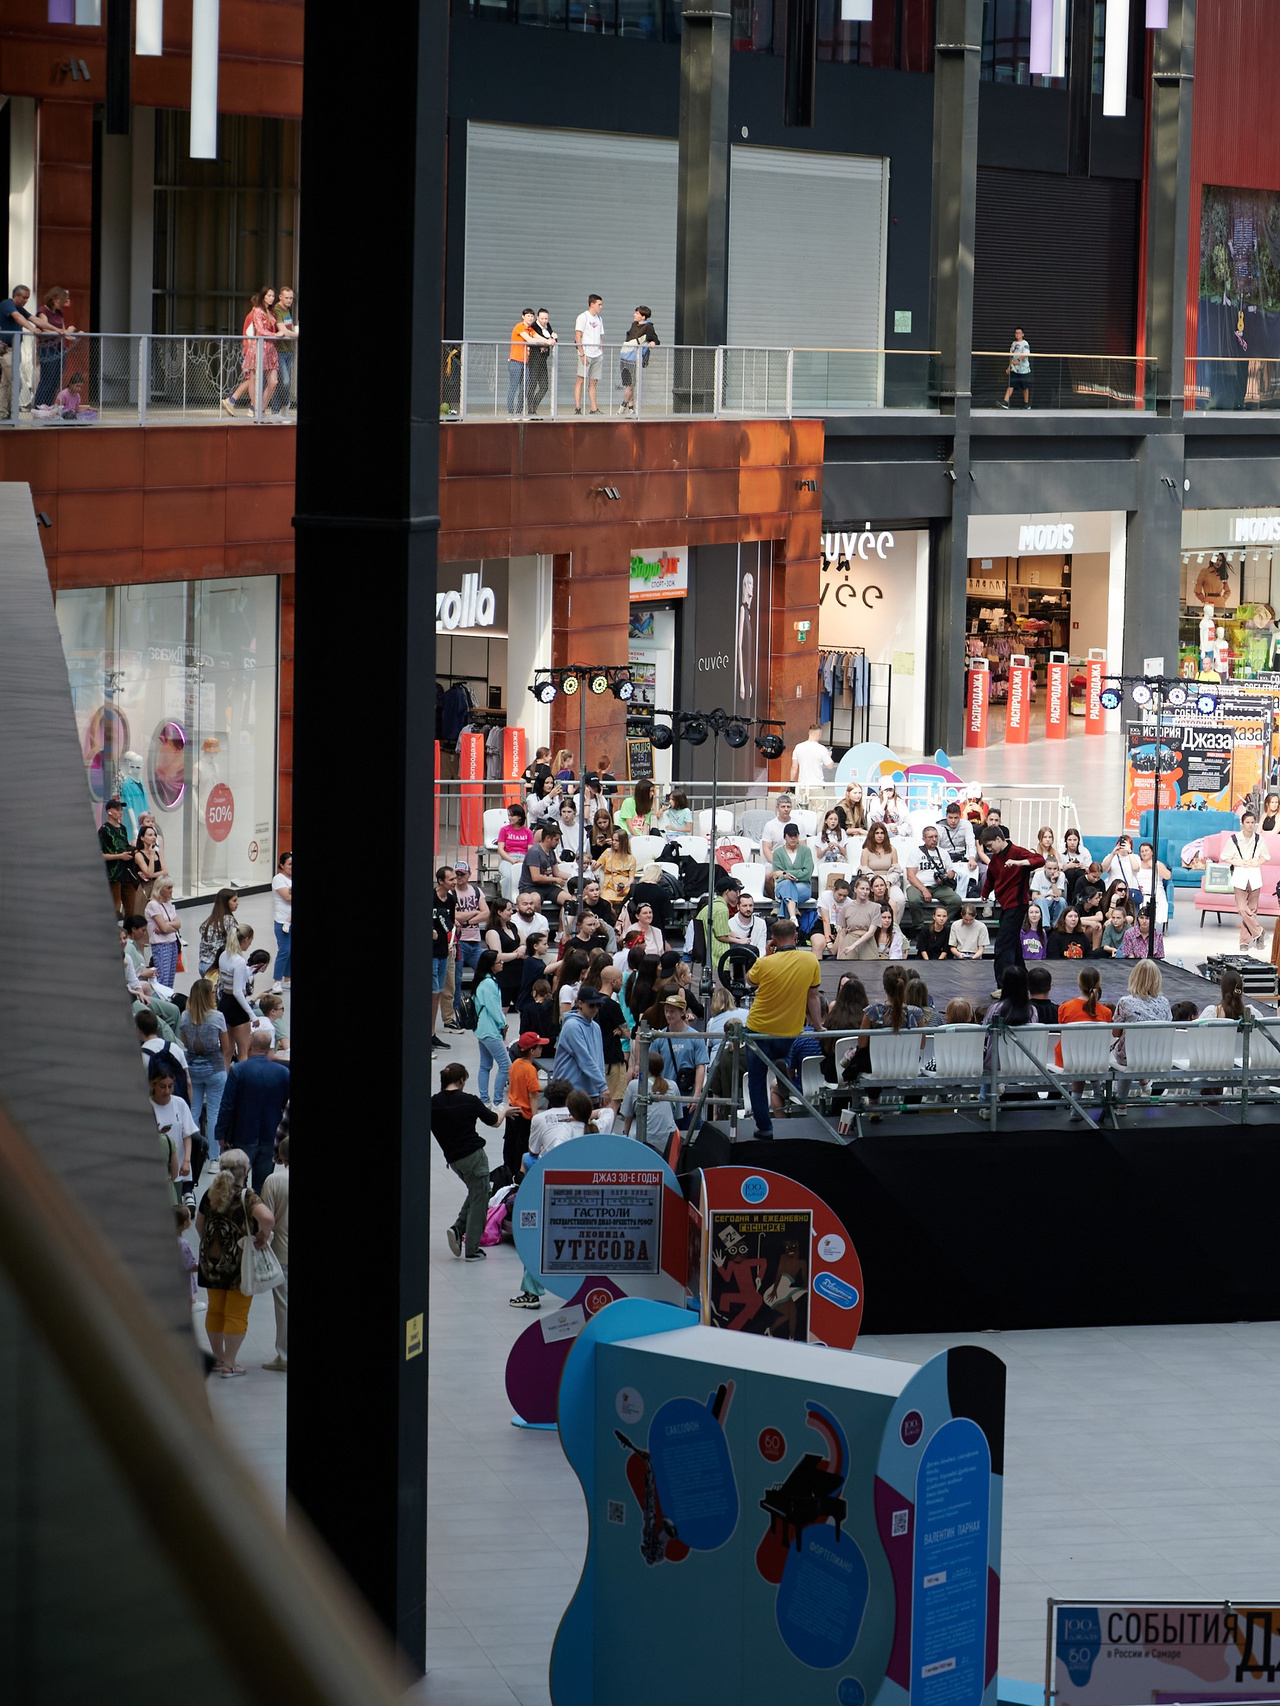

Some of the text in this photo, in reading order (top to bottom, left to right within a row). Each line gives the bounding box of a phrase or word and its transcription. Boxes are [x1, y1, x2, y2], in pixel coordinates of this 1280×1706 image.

[1018, 523, 1075, 551] MODIS
[971, 673, 983, 732] РАСПРОДАЖА
[1010, 670, 1022, 728] РАСПРОДАЖА
[1050, 667, 1061, 724] РАСПРОДАЖА
[1090, 664, 1101, 720] РАСПРОДАЖА
[1182, 727, 1233, 750] Джаза
[209, 805, 232, 823] 50%
[592, 1172, 660, 1184] ДЖАЗ 30-Е ГОДЫ
[574, 1207, 630, 1218] ГАСТРОЛИ
[714, 1215, 750, 1223] СЕГОДНЯ
[578, 1231, 625, 1239] ЛЕОНИДА
[740, 1223, 785, 1232] ГОСЦИРКЕ
[553, 1239, 649, 1261] УТЕСОВА
[665, 1420, 700, 1436] САКСОФОН
[924, 1520, 981, 1546] ВАЛЕНТИН ПАРНАХ
[809, 1541, 853, 1573] ФОРТЕПИАНО
[1107, 1612, 1238, 1644] СОБЫТИЯ
[1068, 1648, 1091, 1663] 60
[1107, 1650, 1112, 1658] в
[1114, 1649, 1143, 1658] России
[1151, 1649, 1181, 1660] Самаре
